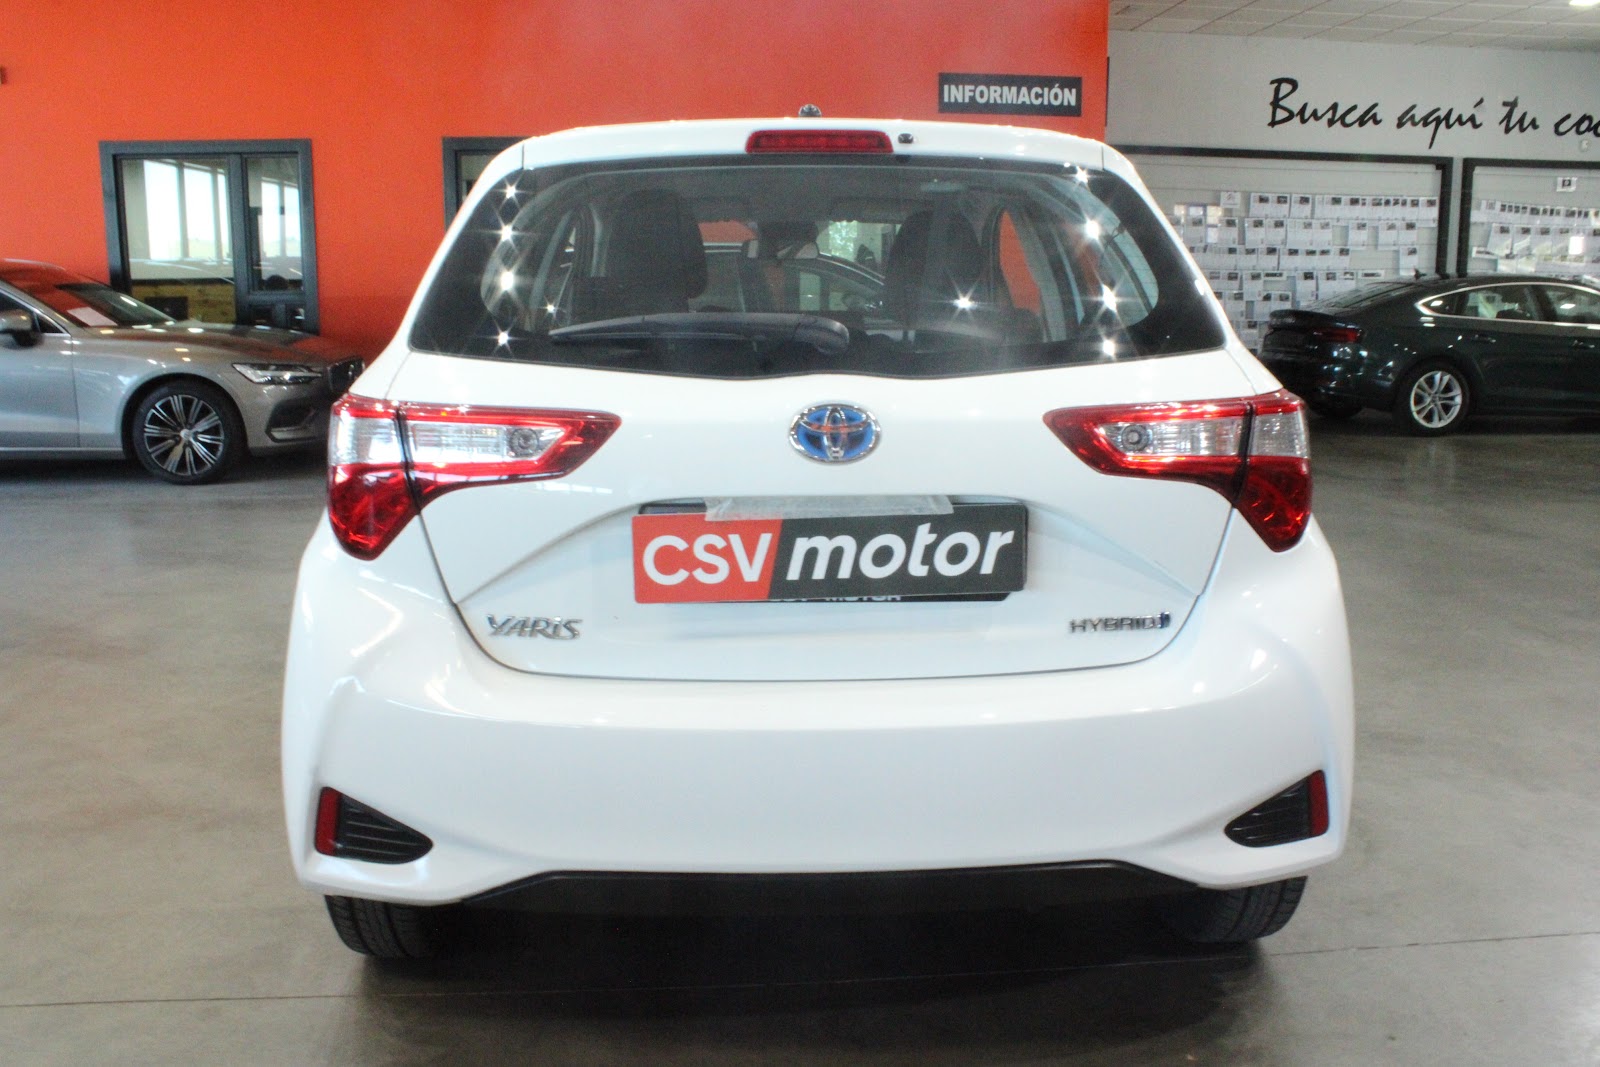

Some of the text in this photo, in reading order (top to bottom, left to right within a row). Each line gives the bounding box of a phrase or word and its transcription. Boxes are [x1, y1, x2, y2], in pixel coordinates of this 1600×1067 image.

[943, 83, 1077, 106] INFORMACIÓN
[1267, 77, 1383, 128] Busca
[1396, 97, 1483, 149] aquí
[1499, 96, 1540, 134] tu
[642, 522, 1015, 585] CSV motor
[1069, 615, 1156, 632] HYBRID
